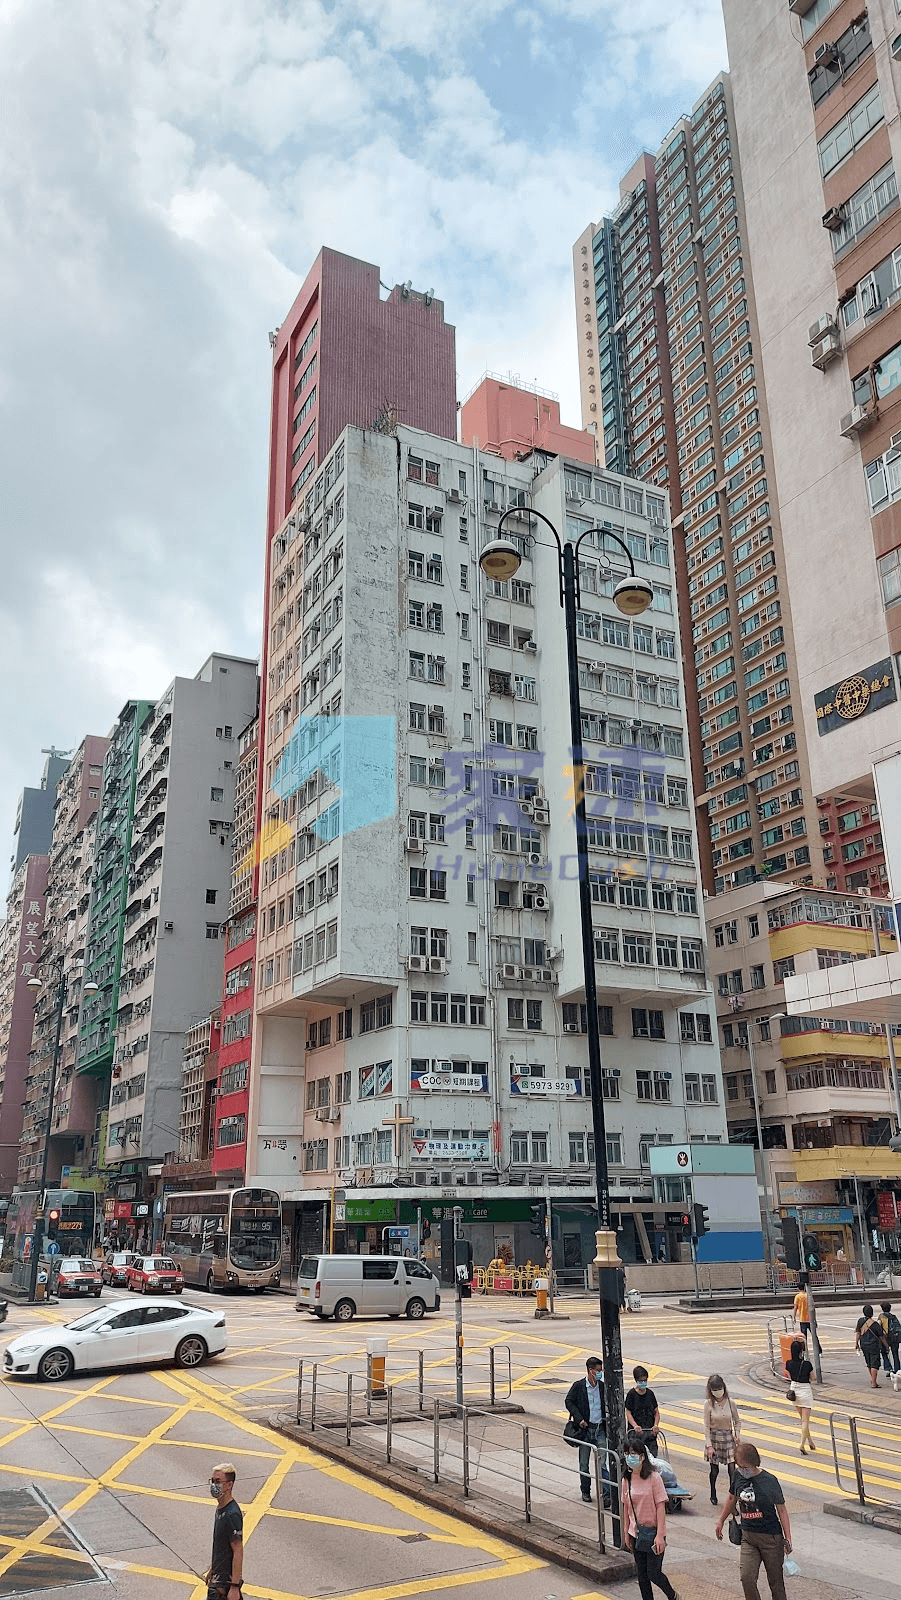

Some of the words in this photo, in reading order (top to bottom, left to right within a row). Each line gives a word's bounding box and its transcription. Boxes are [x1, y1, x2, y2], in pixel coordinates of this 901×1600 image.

[19, 901, 42, 977] 展望大廈
[422, 1076, 442, 1085] COC
[530, 1081, 553, 1090] 5973
[71, 1221, 83, 1230] 271
[261, 1221, 271, 1231] 95
